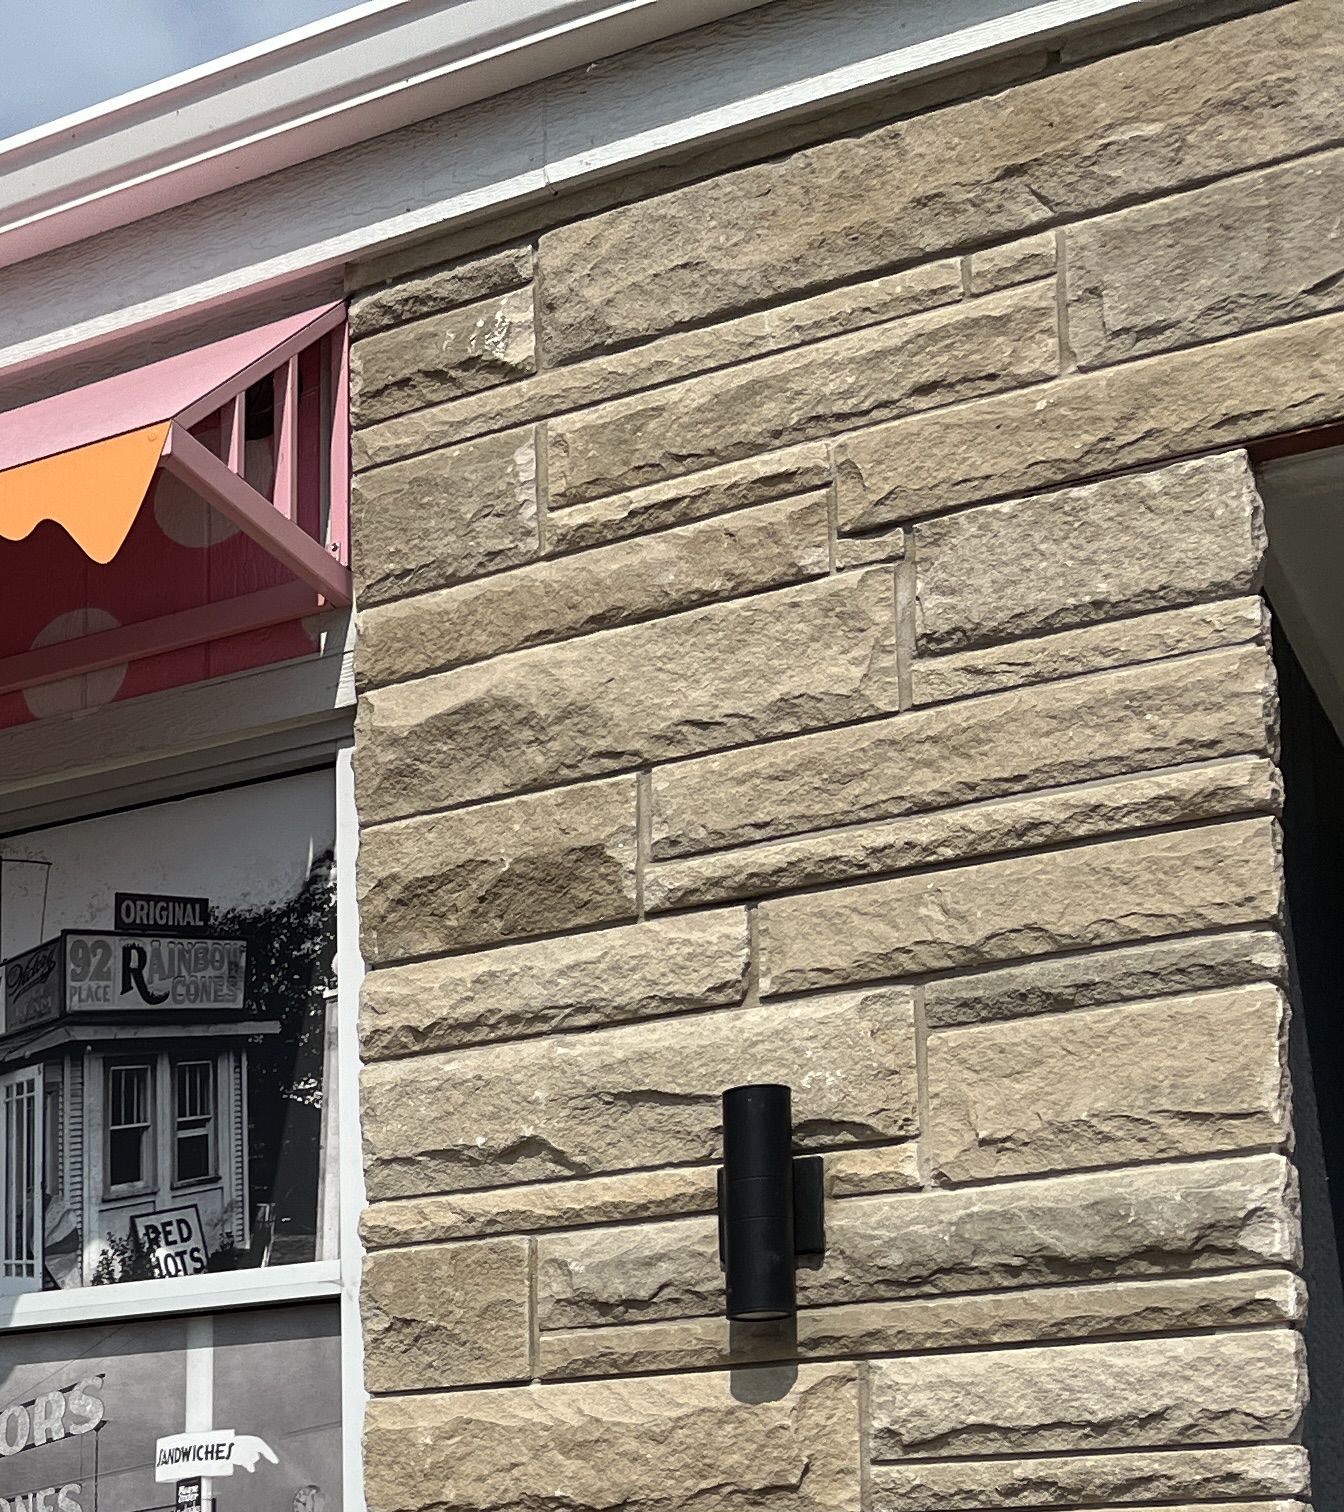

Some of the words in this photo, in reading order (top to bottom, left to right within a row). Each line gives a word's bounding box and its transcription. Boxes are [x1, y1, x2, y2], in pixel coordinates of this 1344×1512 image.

[120, 899, 205, 927] ORIGINAL
[69, 939, 112, 982] 92
[120, 939, 247, 1005] RAINBOW
[69, 984, 111, 1004] PLACE
[171, 975, 241, 1004] CONES
[144, 1218, 193, 1248] RED
[156, 1442, 235, 1467] SANDWICHES
